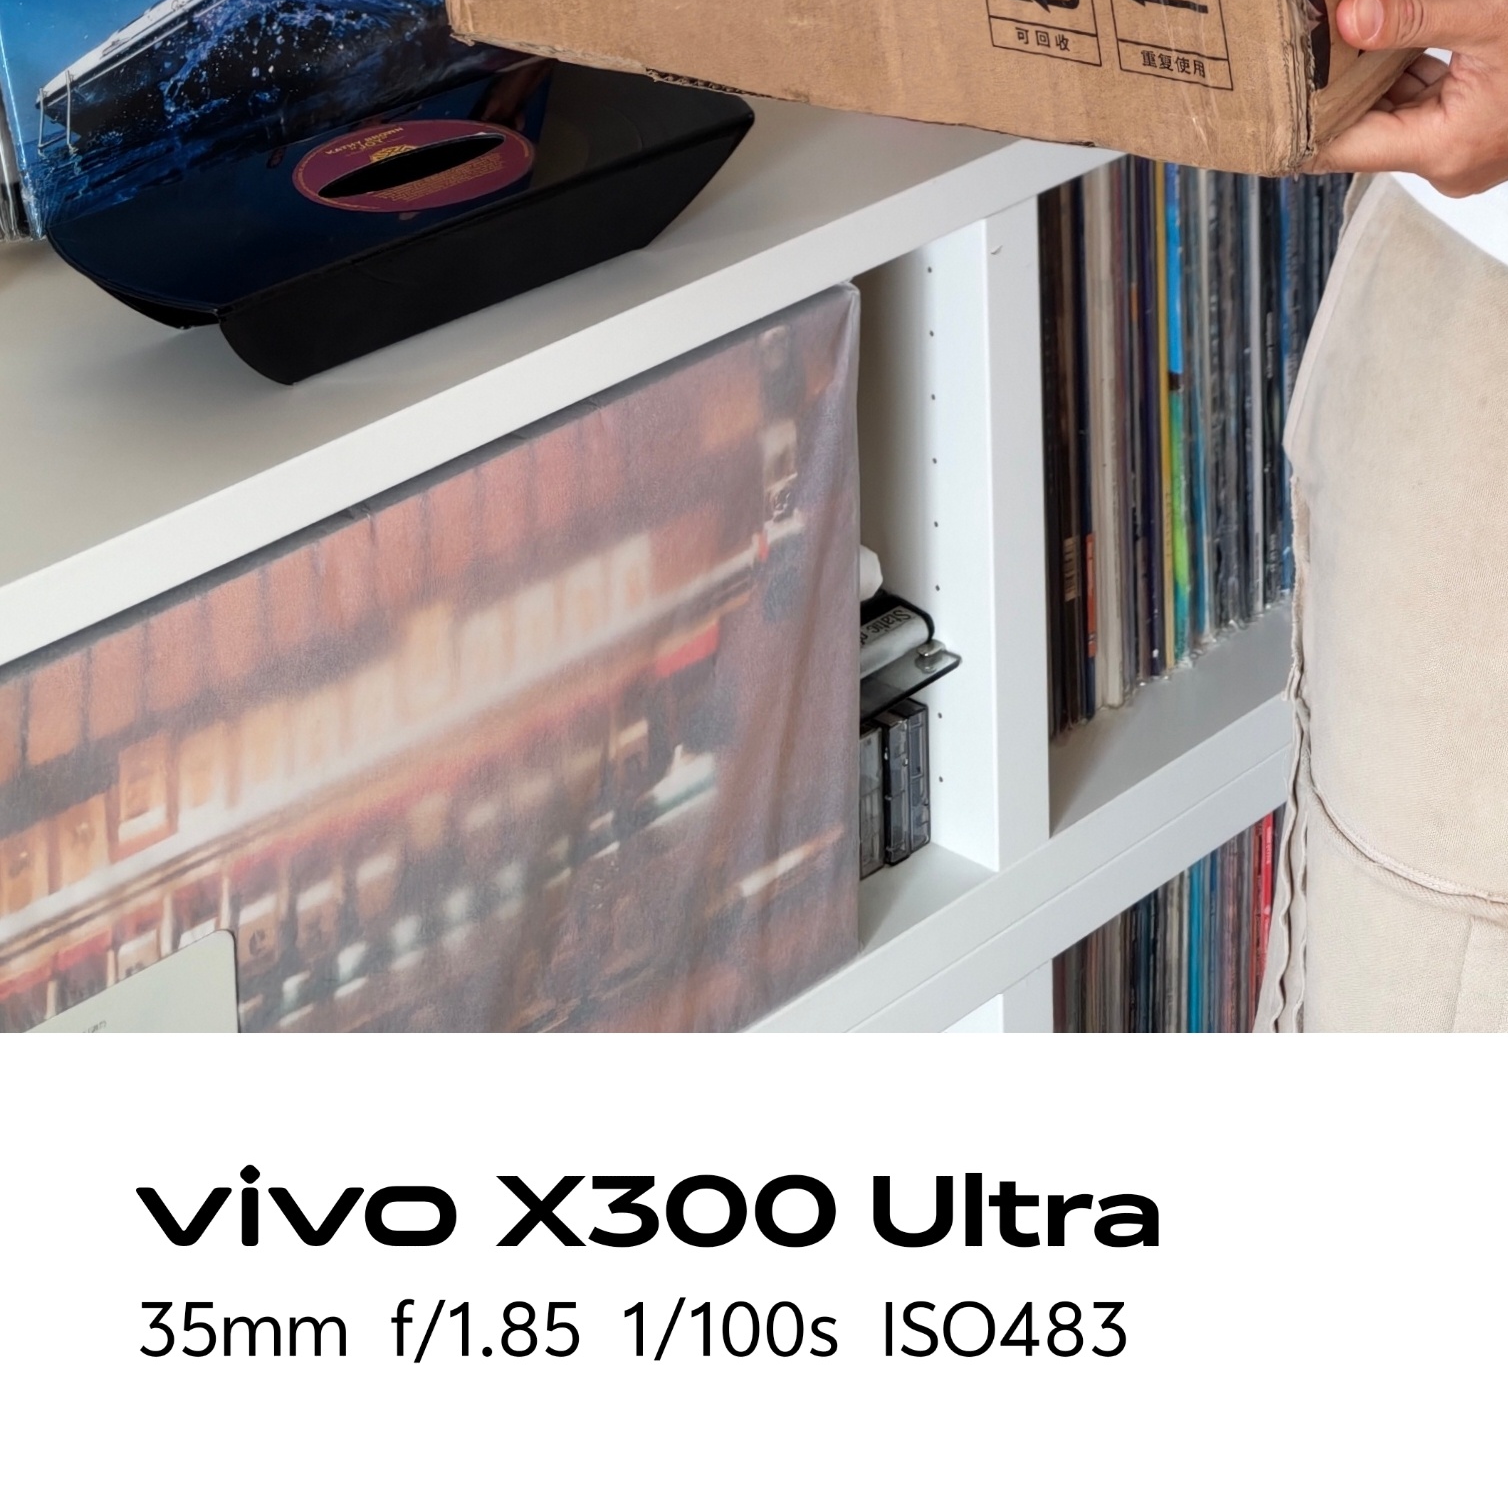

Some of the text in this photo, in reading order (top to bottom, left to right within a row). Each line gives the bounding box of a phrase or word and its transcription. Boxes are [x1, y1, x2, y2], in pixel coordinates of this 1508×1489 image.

[1014, 26, 1071, 52] 可回收
[1140, 50, 1207, 79] 重复使用
[866, 609, 911, 633] Static
